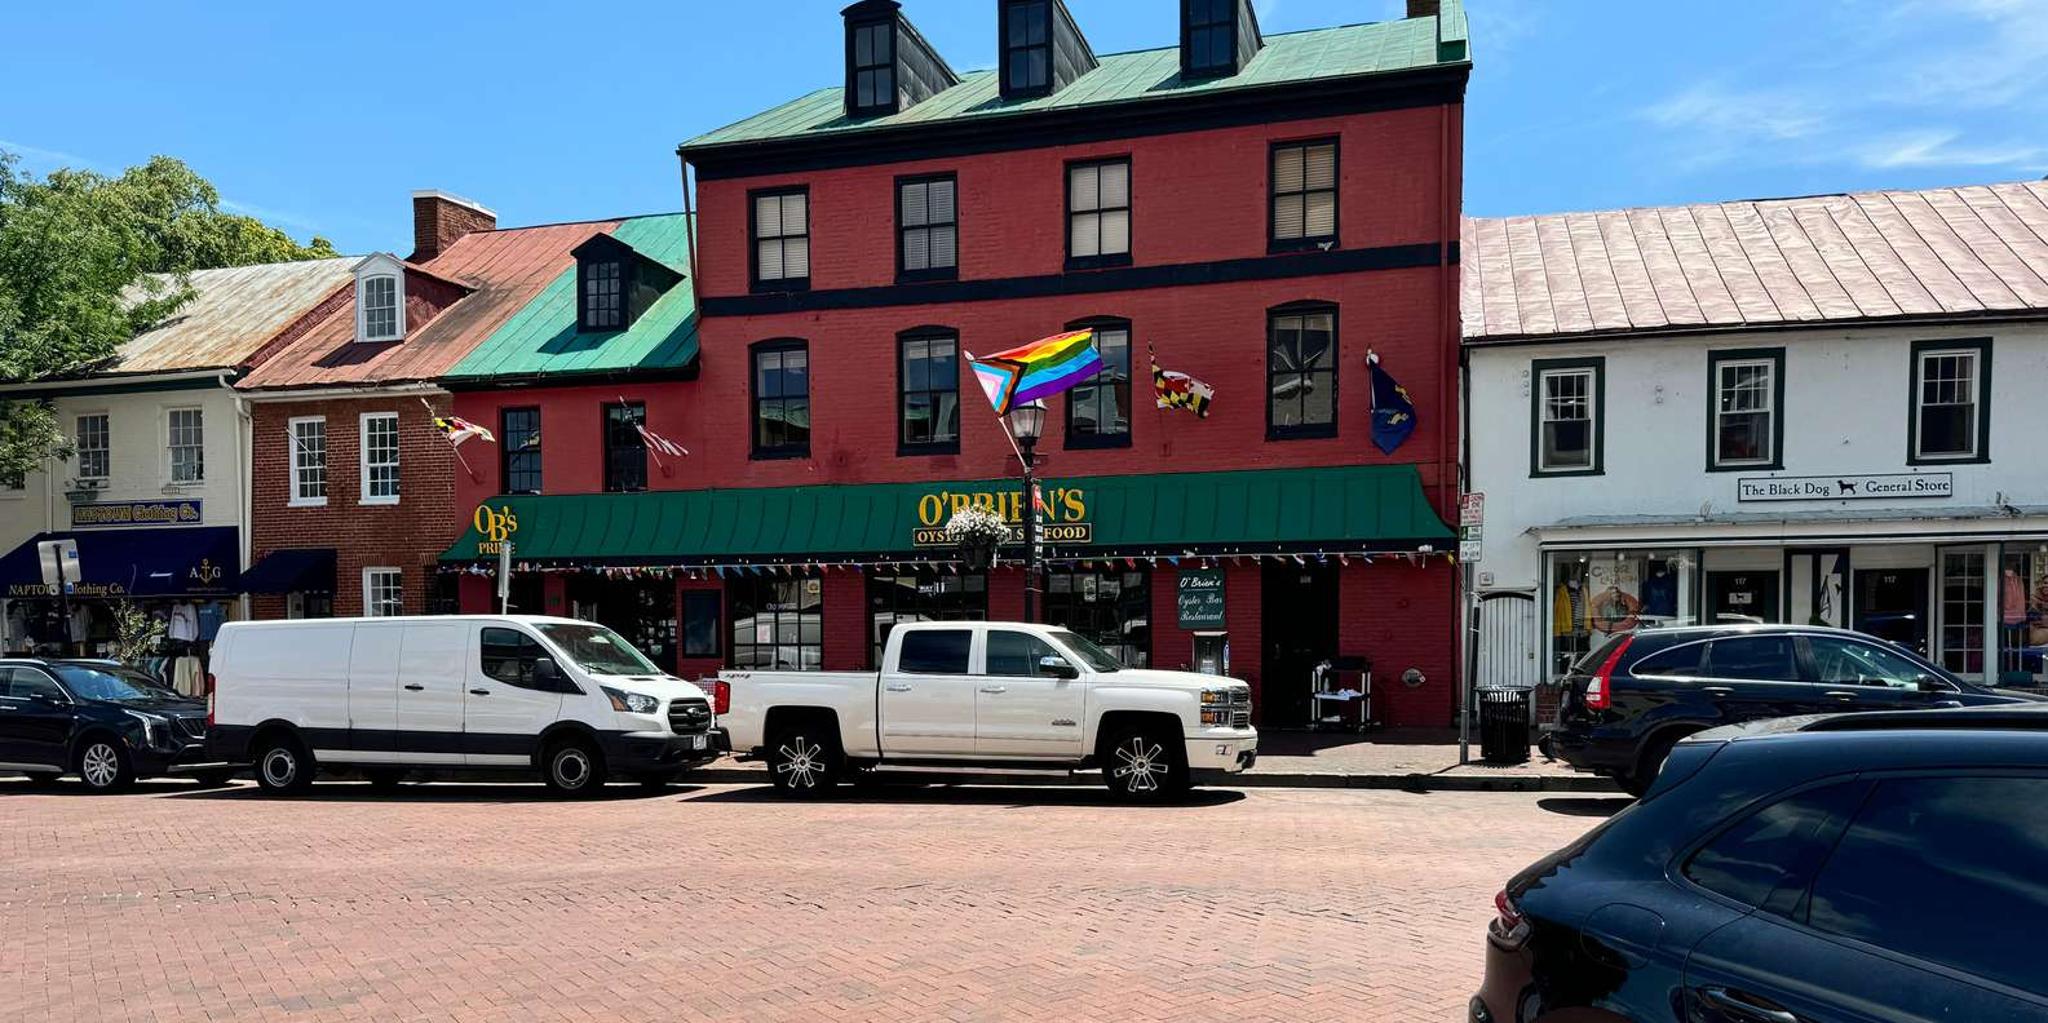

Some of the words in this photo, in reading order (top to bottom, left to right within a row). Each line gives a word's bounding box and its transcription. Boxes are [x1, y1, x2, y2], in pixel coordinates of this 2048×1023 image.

[1742, 484, 1765, 495] The
[1769, 483, 1800, 496] Black
[1805, 482, 1830, 497] Dog
[1866, 481, 1911, 493] General
[1915, 479, 1949, 491] Store
[1016, 527, 1086, 540] SFOOD
[479, 542, 516, 554] PRI
[9, 584, 57, 596] NAPTO
[70, 582, 107, 598] lothing
